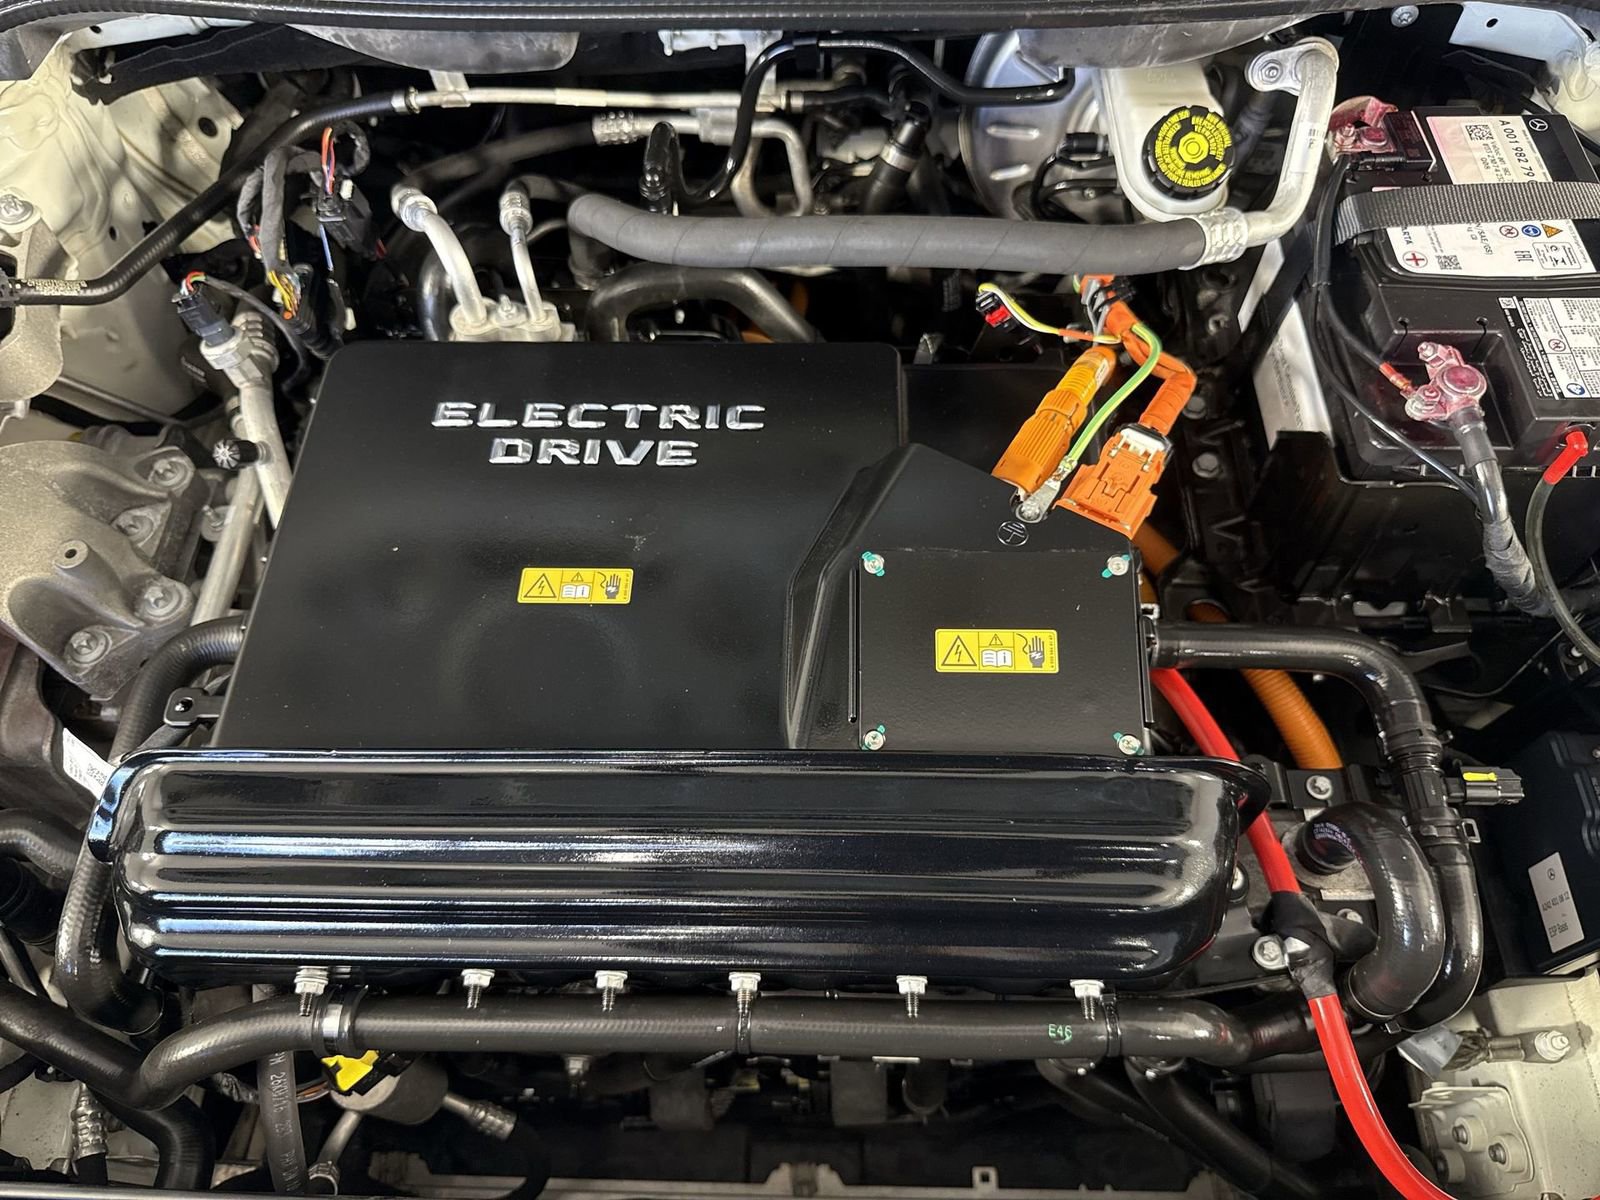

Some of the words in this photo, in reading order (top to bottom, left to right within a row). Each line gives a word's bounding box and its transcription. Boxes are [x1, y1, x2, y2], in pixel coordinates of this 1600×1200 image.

[1504, 128, 1519, 143] 001
[1512, 147, 1528, 163] 982
[1521, 166, 1535, 177] 79
[1401, 226, 1413, 245] ARTA
[431, 402, 766, 430] ELECTRIC
[489, 438, 699, 467] DRIVE
